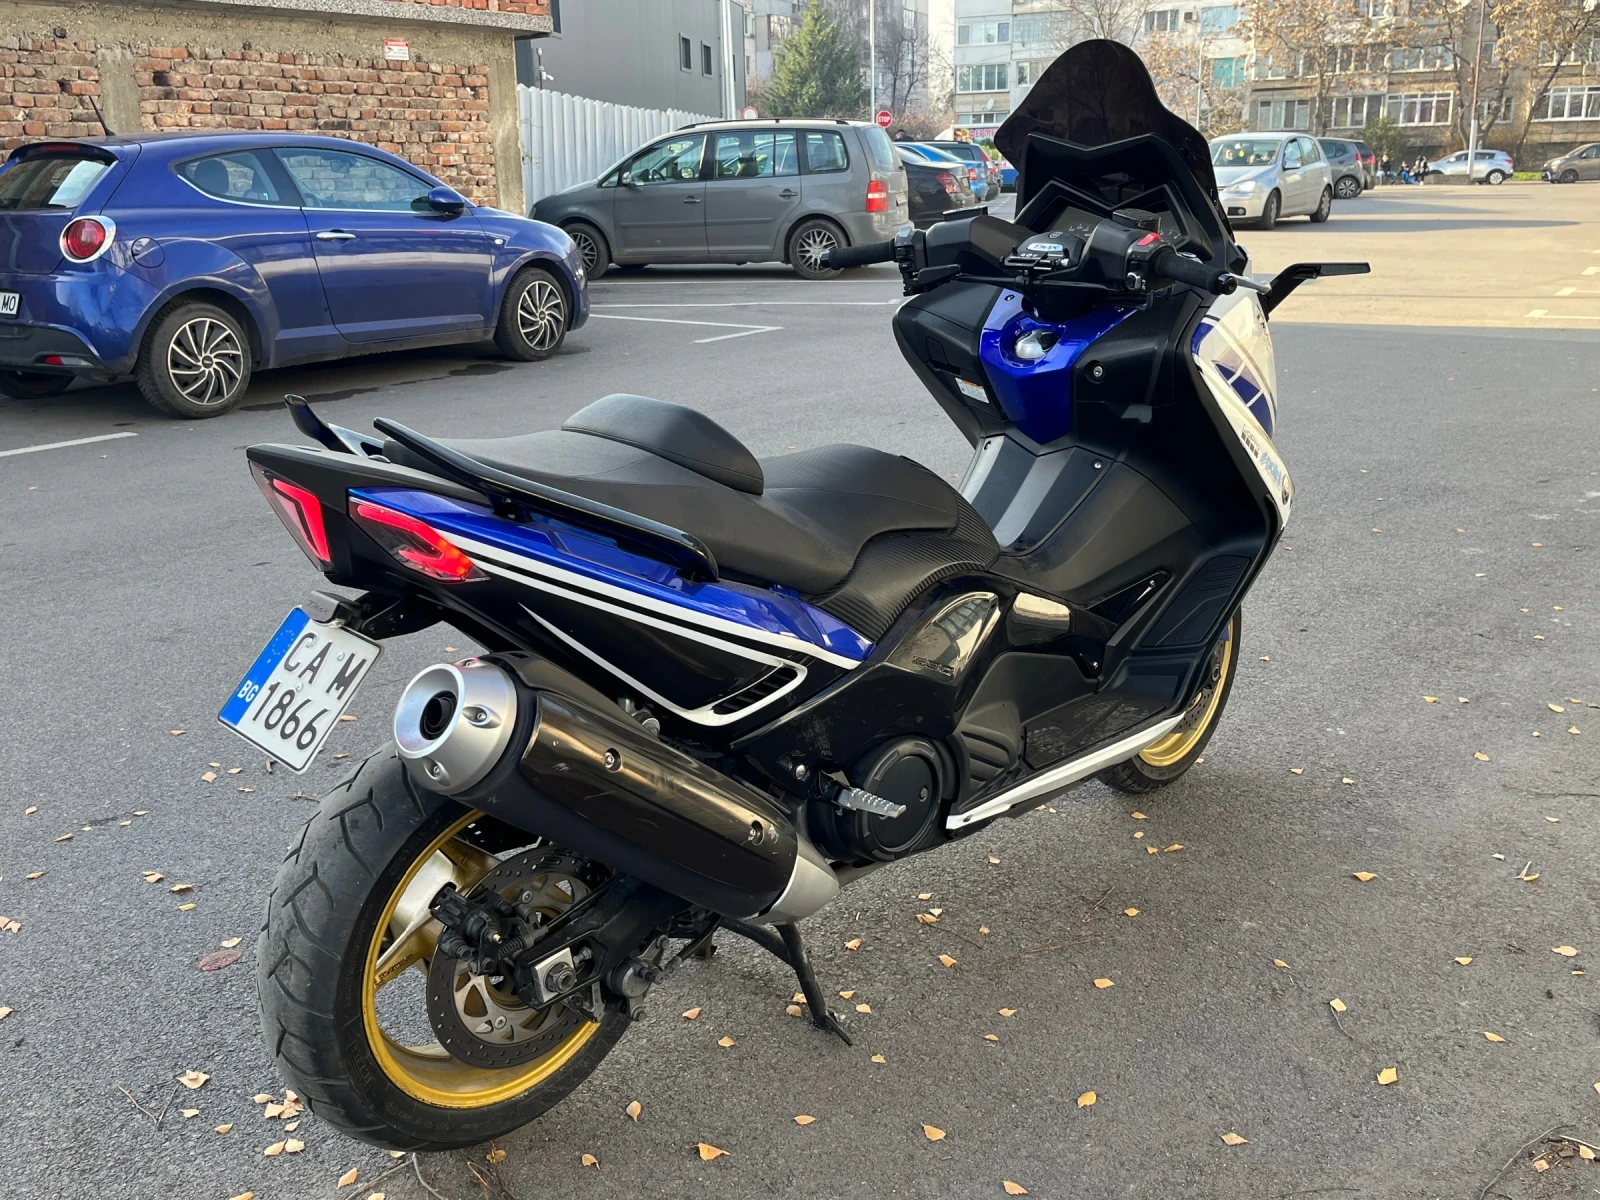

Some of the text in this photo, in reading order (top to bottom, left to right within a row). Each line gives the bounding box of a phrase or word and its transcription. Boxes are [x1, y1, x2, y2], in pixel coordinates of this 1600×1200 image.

[878, 115, 891, 123] STOP
[969, 129, 997, 138] ФЕРМЕ
[2, 294, 17, 312] MO
[284, 632, 368, 701] CA M
[236, 679, 260, 703] BG
[251, 681, 330, 751] 1866
